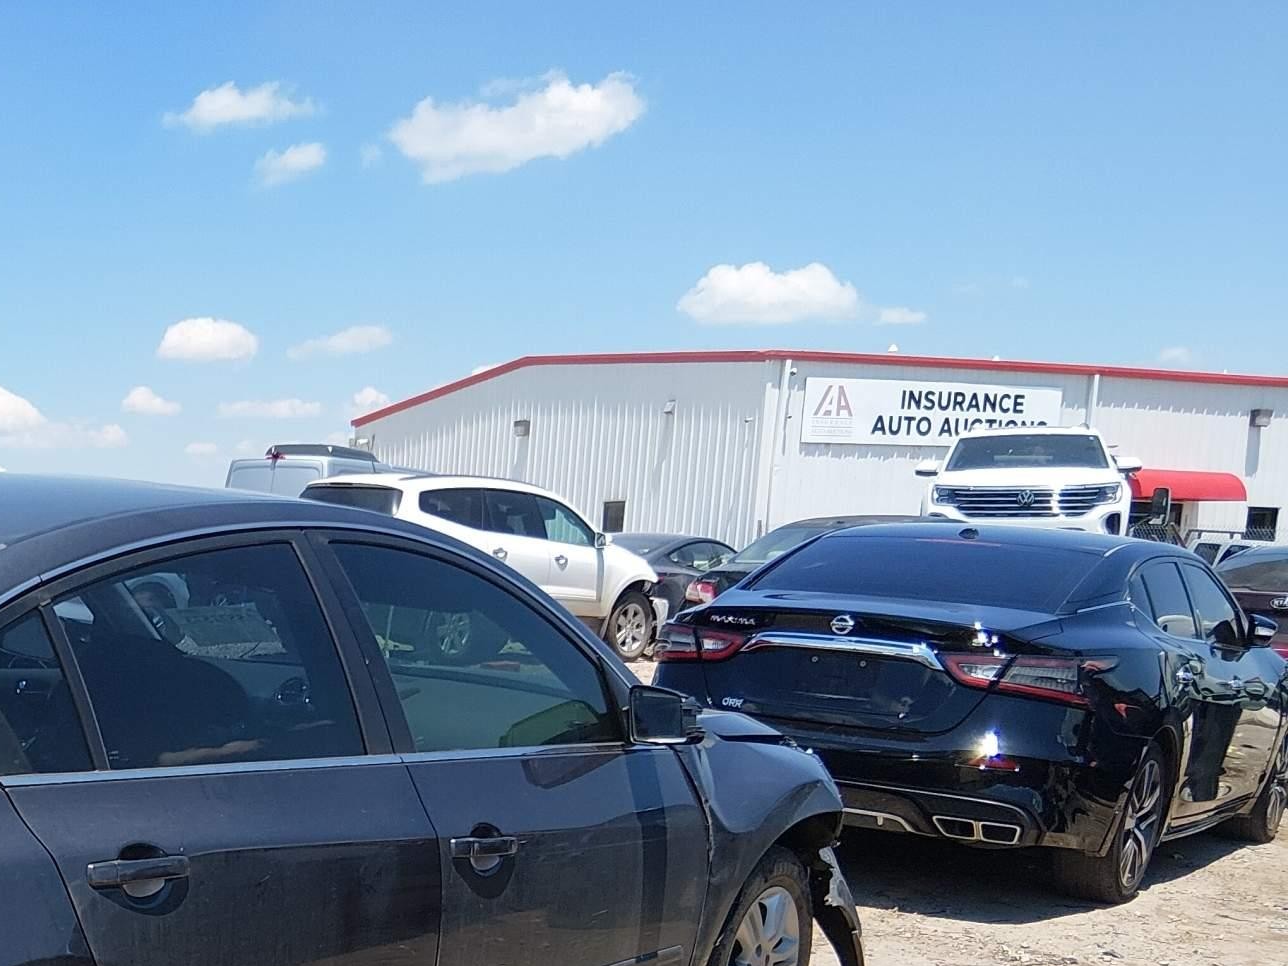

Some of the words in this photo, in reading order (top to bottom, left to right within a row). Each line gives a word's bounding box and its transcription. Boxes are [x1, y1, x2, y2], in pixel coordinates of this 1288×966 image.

[900, 389, 1026, 414] INSURANCE
[871, 415, 932, 436] AUTO
[710, 615, 755, 626] MAXIMA
